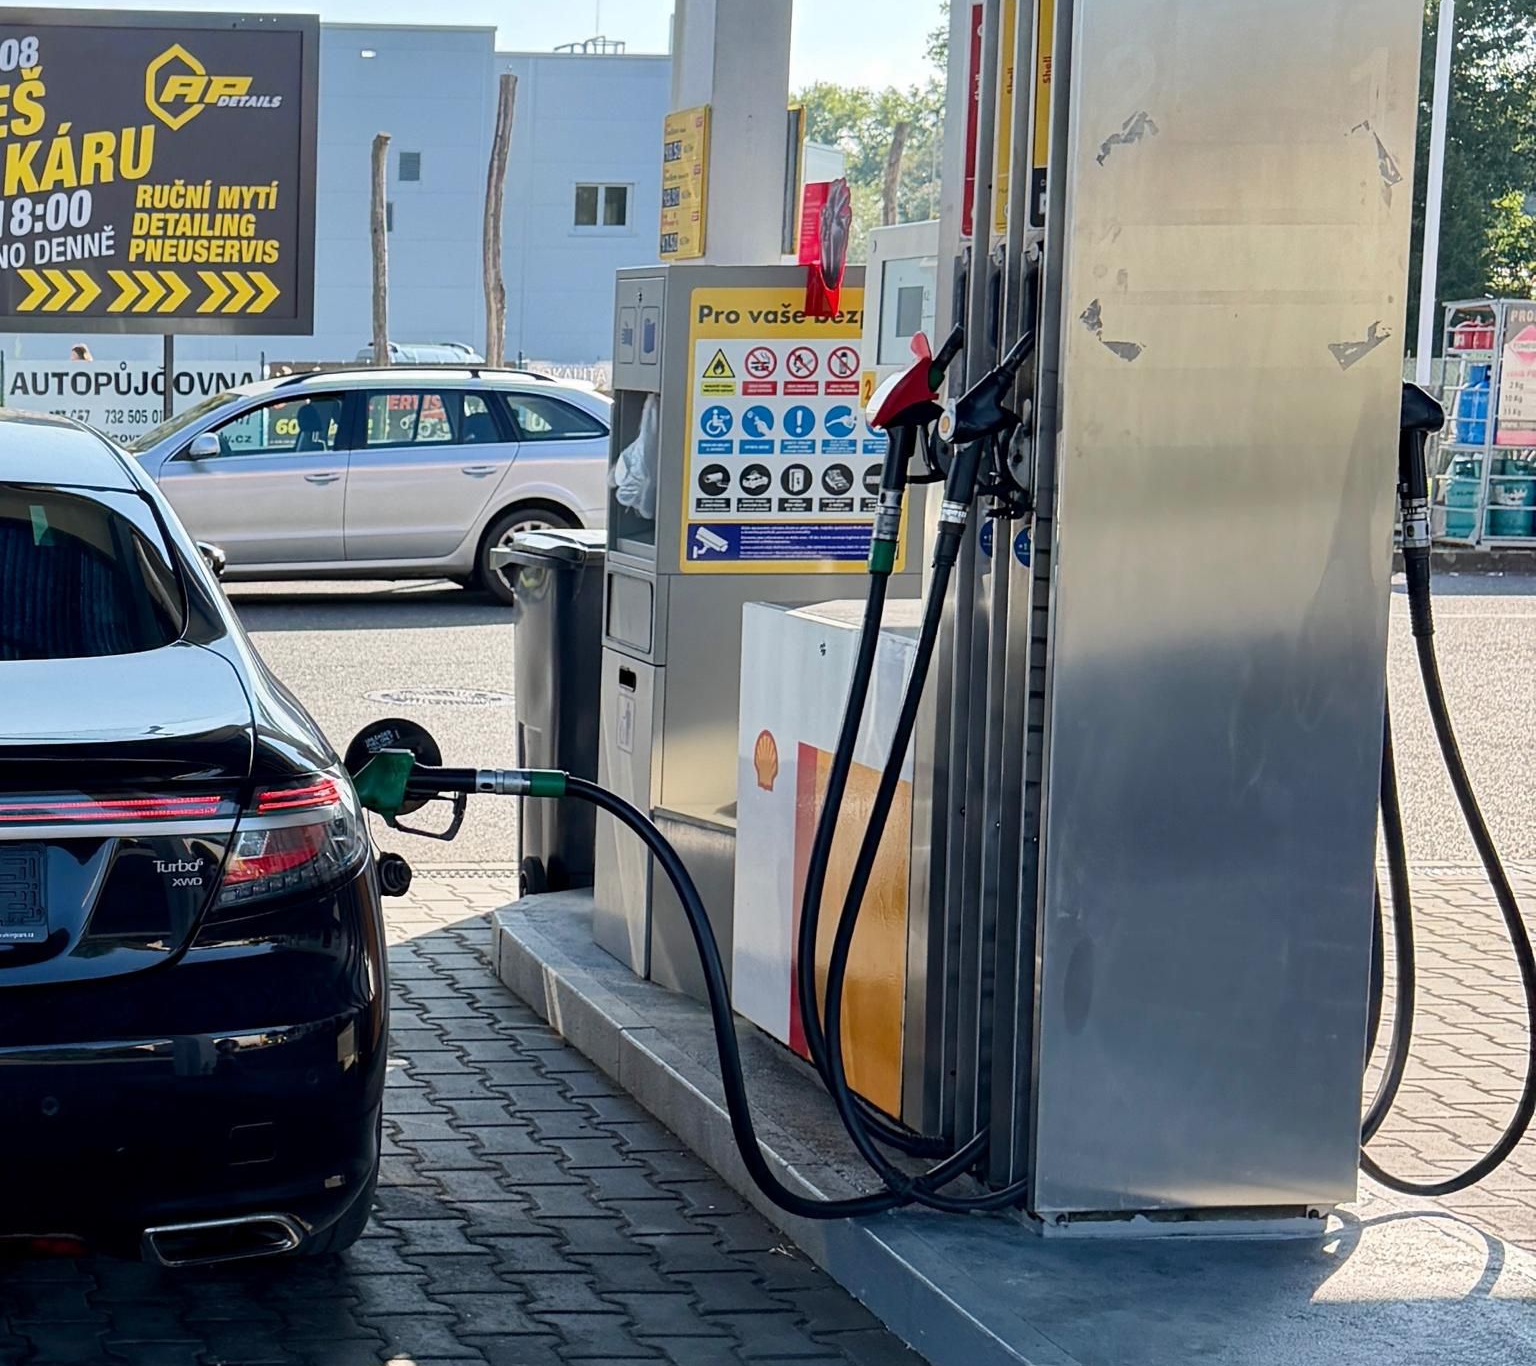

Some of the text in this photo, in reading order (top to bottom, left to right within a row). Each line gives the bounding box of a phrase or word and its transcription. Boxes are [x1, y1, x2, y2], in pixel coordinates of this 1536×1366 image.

[217, 95, 283, 108] DETAILS
[3, 122, 156, 197] KÁRU
[135, 179, 279, 211] RUČNÍ MYTÍ
[132, 212, 257, 237] DETAILING
[34, 225, 116, 267] DENNĚ
[128, 238, 280, 264] PNEUSERVIS
[698, 305, 741, 325] Pro
[749, 303, 806, 325] vaše
[172, 877, 204, 887] XWD
